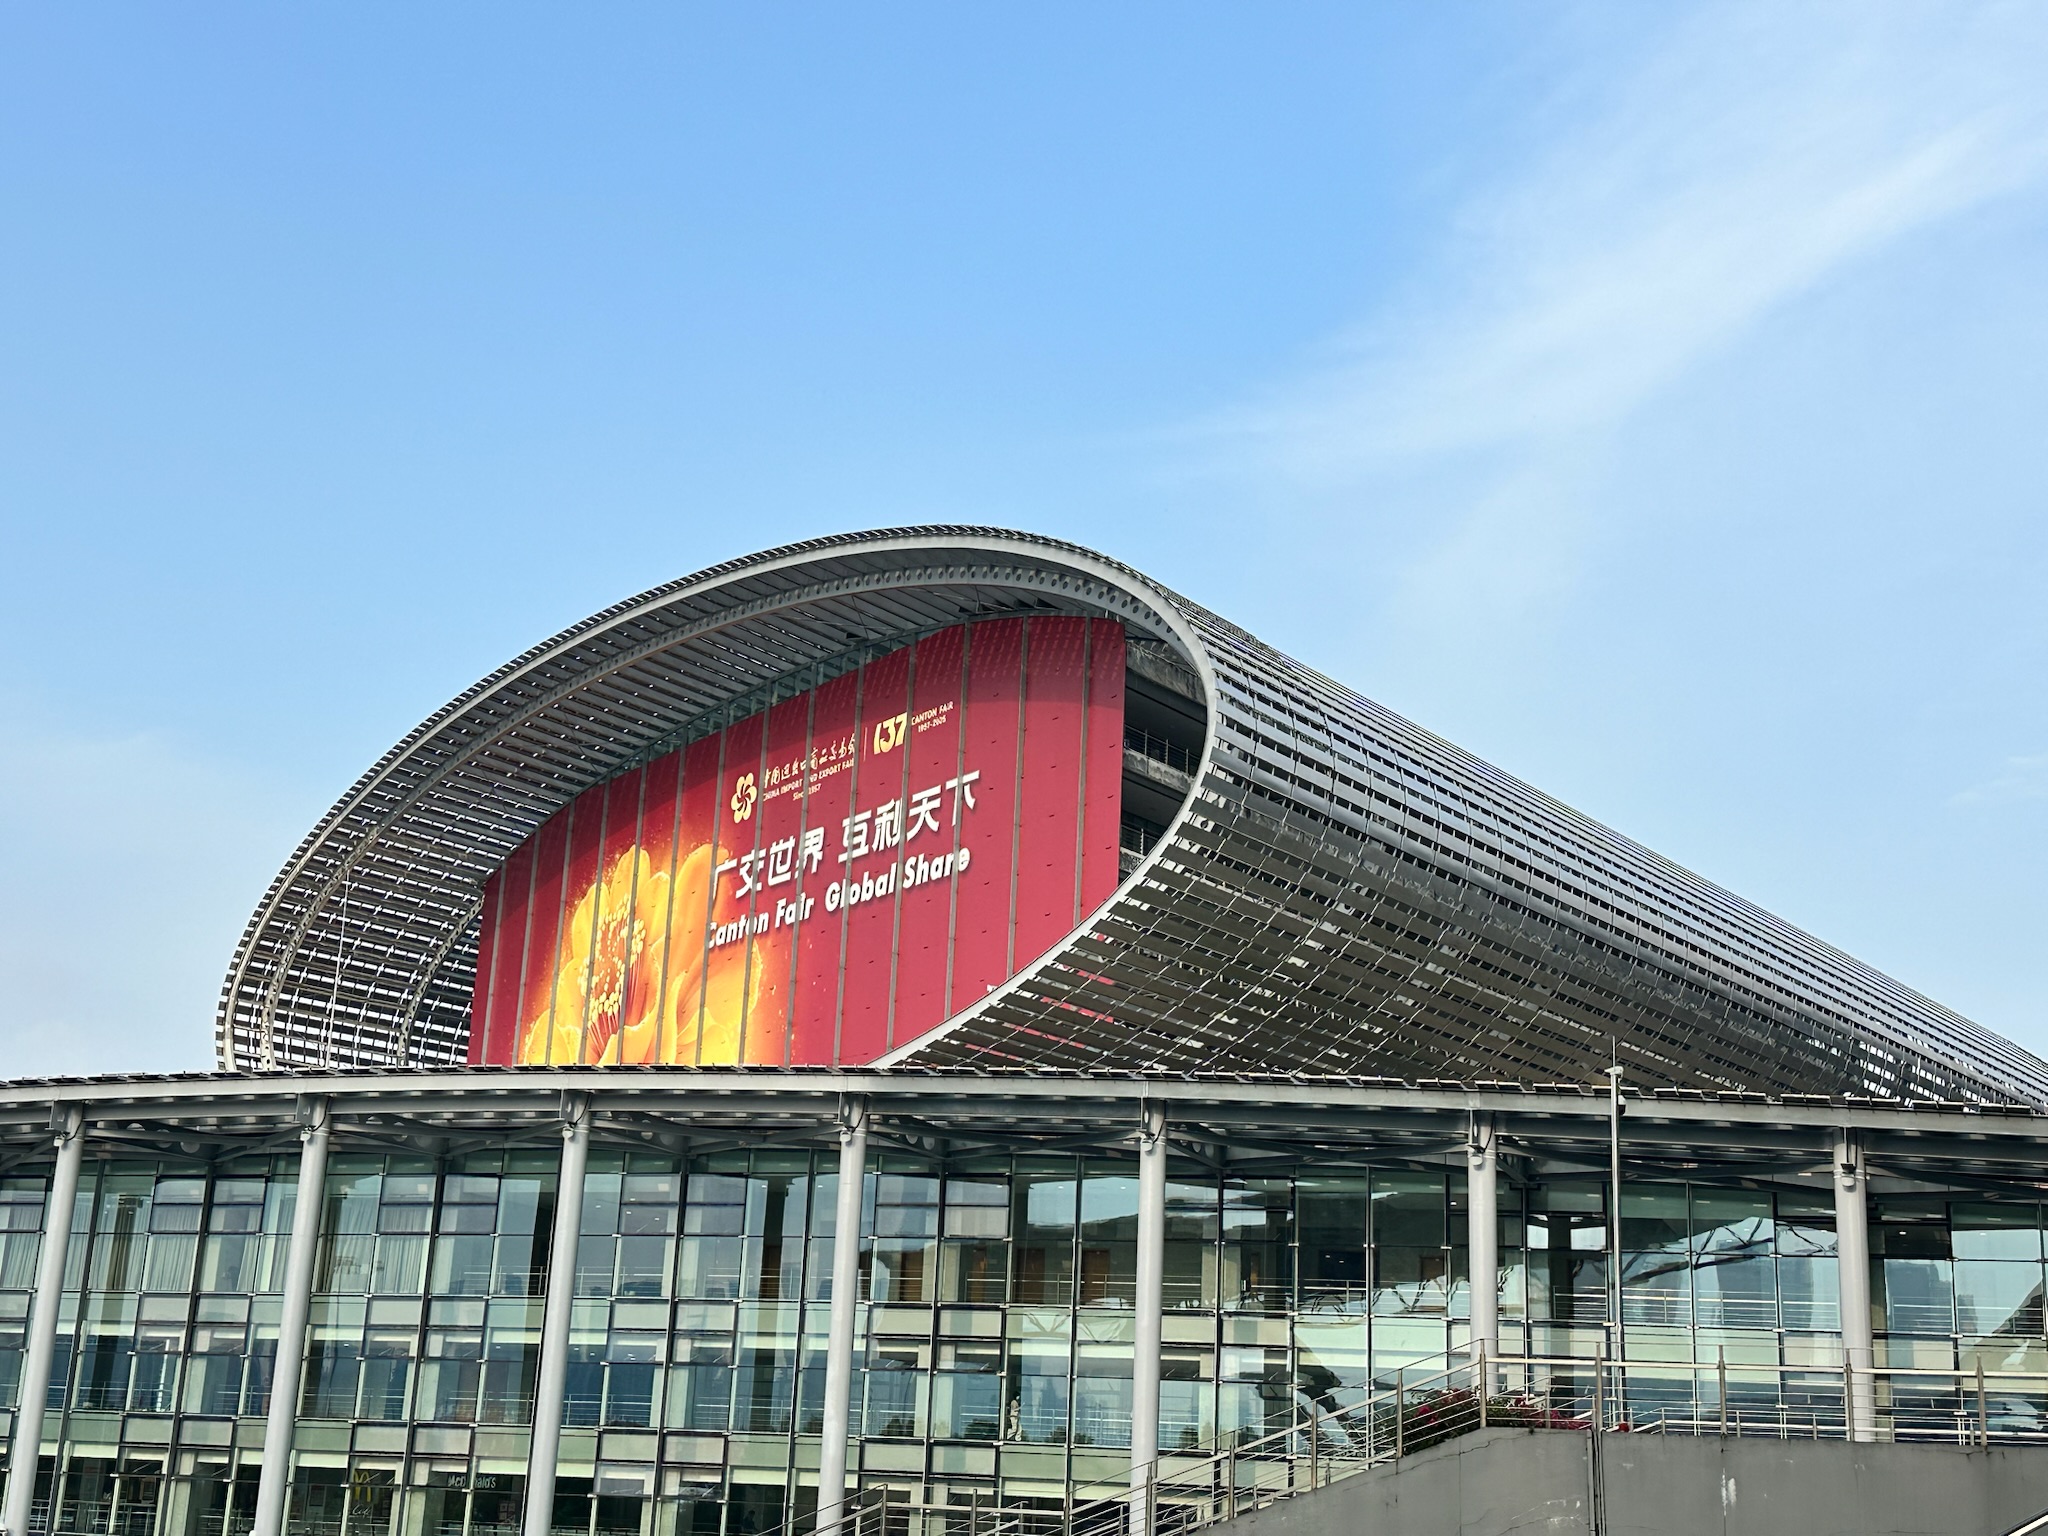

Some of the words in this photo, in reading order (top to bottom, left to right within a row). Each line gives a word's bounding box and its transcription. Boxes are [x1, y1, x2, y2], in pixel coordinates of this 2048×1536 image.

[873, 712, 908, 755] 137
[911, 707, 937, 726] CANTON
[939, 701, 953, 714] FAIR
[818, 763, 842, 780] EXPORT
[712, 827, 825, 901] 广交世界
[837, 769, 980, 864] 互利天下
[708, 911, 769, 949] Canton
[775, 892, 815, 929] Fair
[825, 862, 898, 912] Global
[902, 847, 971, 889] Share
